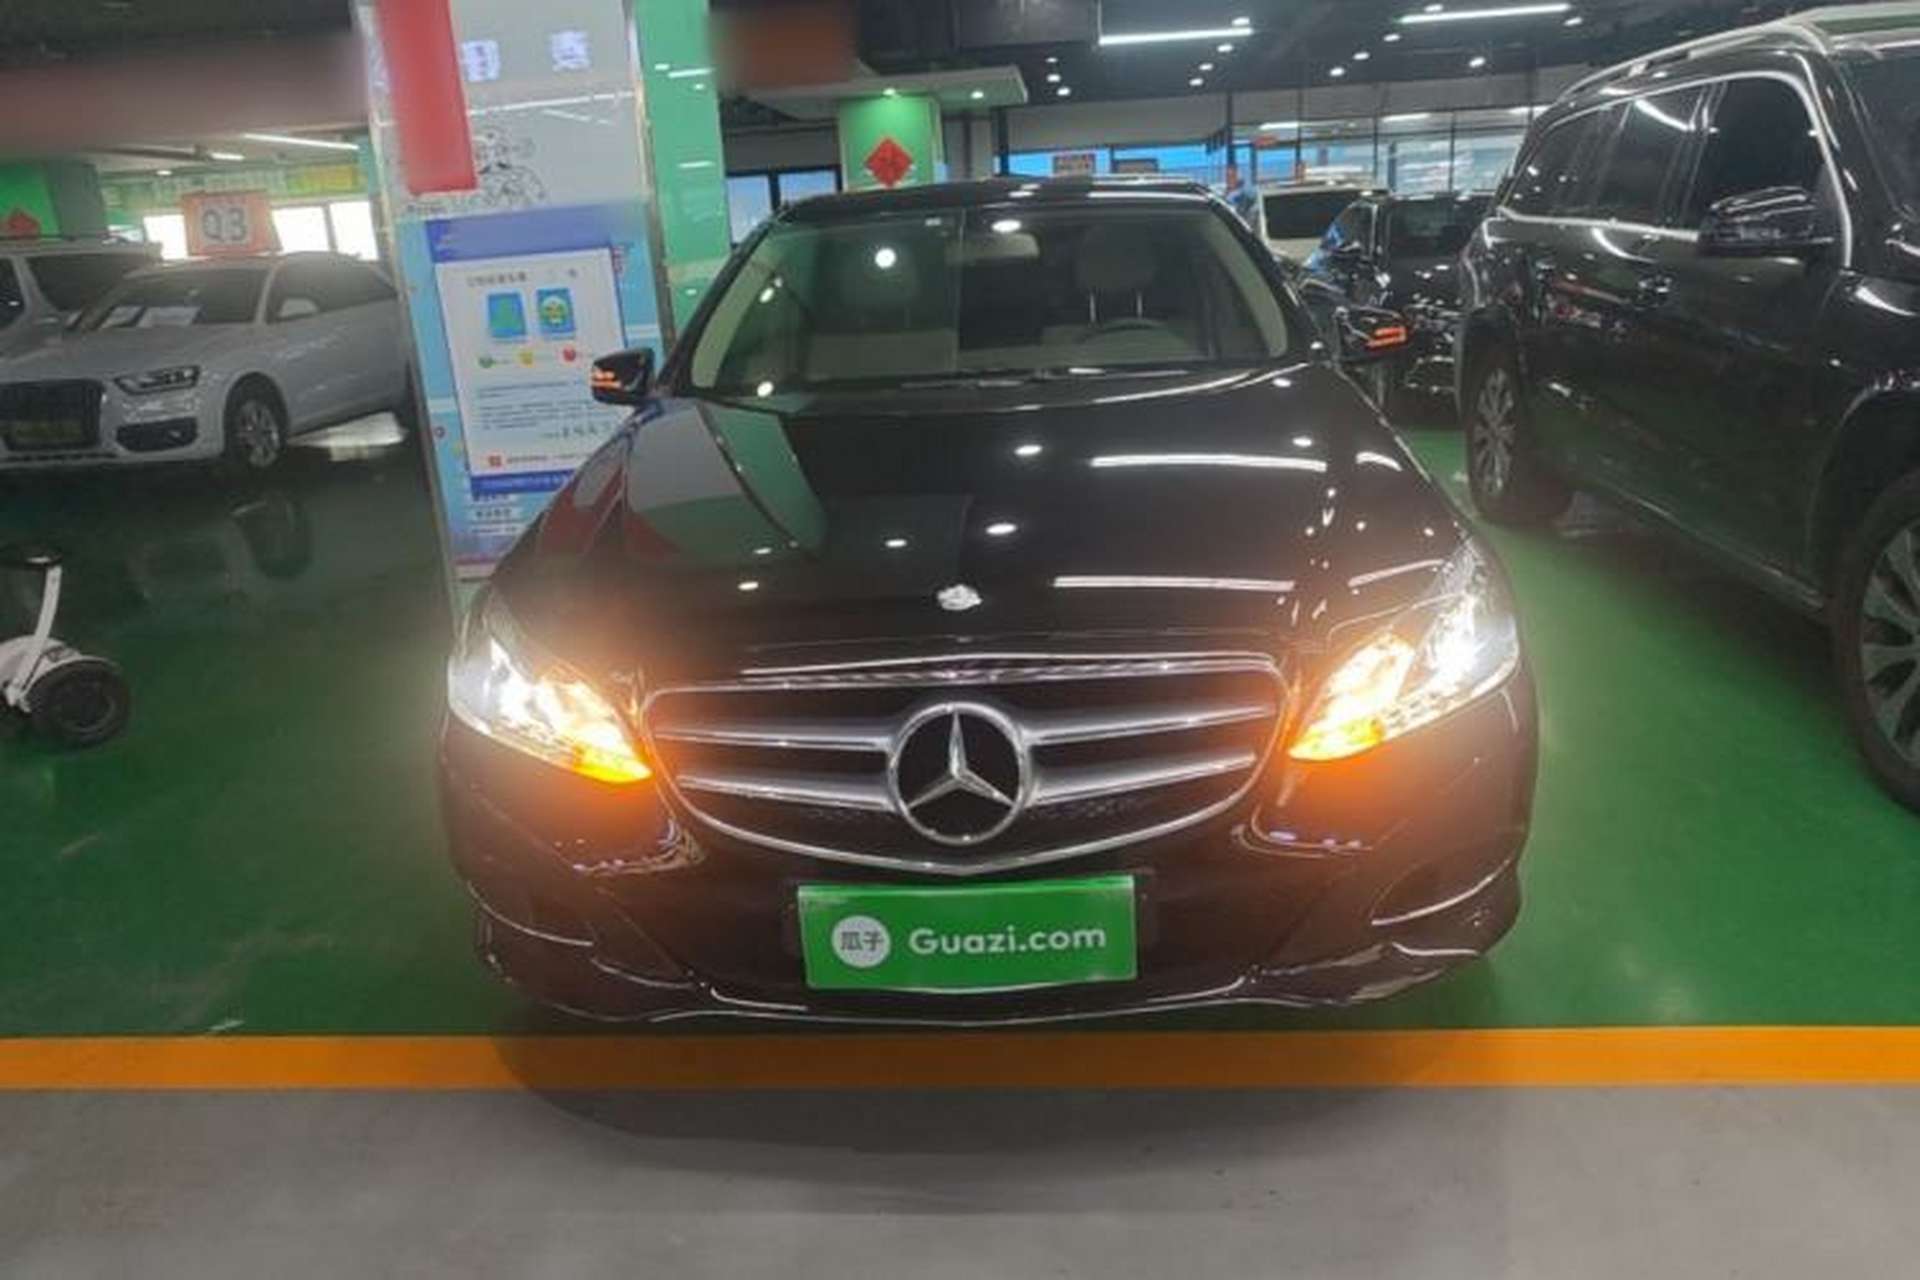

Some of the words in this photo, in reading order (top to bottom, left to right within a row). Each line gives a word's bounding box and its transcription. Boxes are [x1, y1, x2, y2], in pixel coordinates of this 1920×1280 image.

[202, 207, 248, 242] Q3
[840, 930, 884, 952] 瓜子
[908, 924, 1107, 955] Guazi.com
